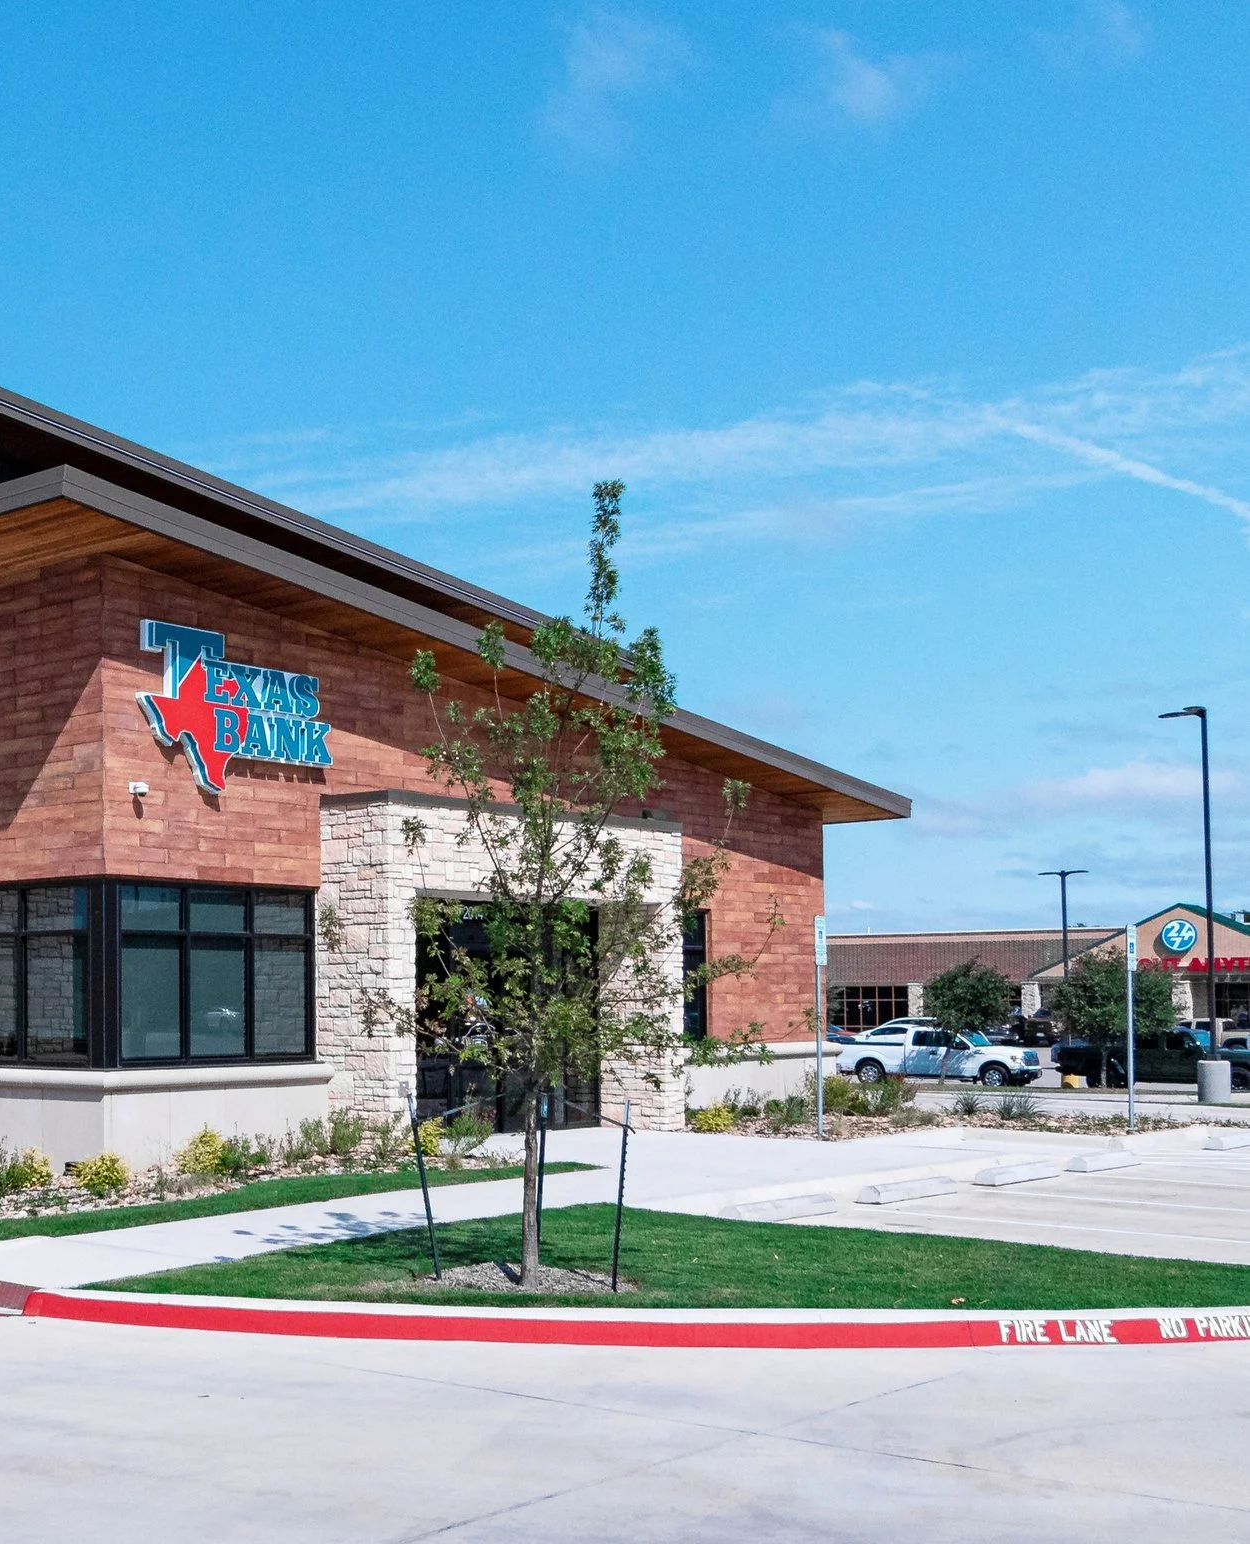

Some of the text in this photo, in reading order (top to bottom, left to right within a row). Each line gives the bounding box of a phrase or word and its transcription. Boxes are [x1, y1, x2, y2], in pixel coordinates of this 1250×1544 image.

[147, 620, 319, 718] TEXAS
[214, 708, 333, 765] BANK
[998, 1320, 1050, 1343] FIRE
[1058, 1319, 1118, 1344] LANE
[1156, 1317, 1188, 1339] NO
